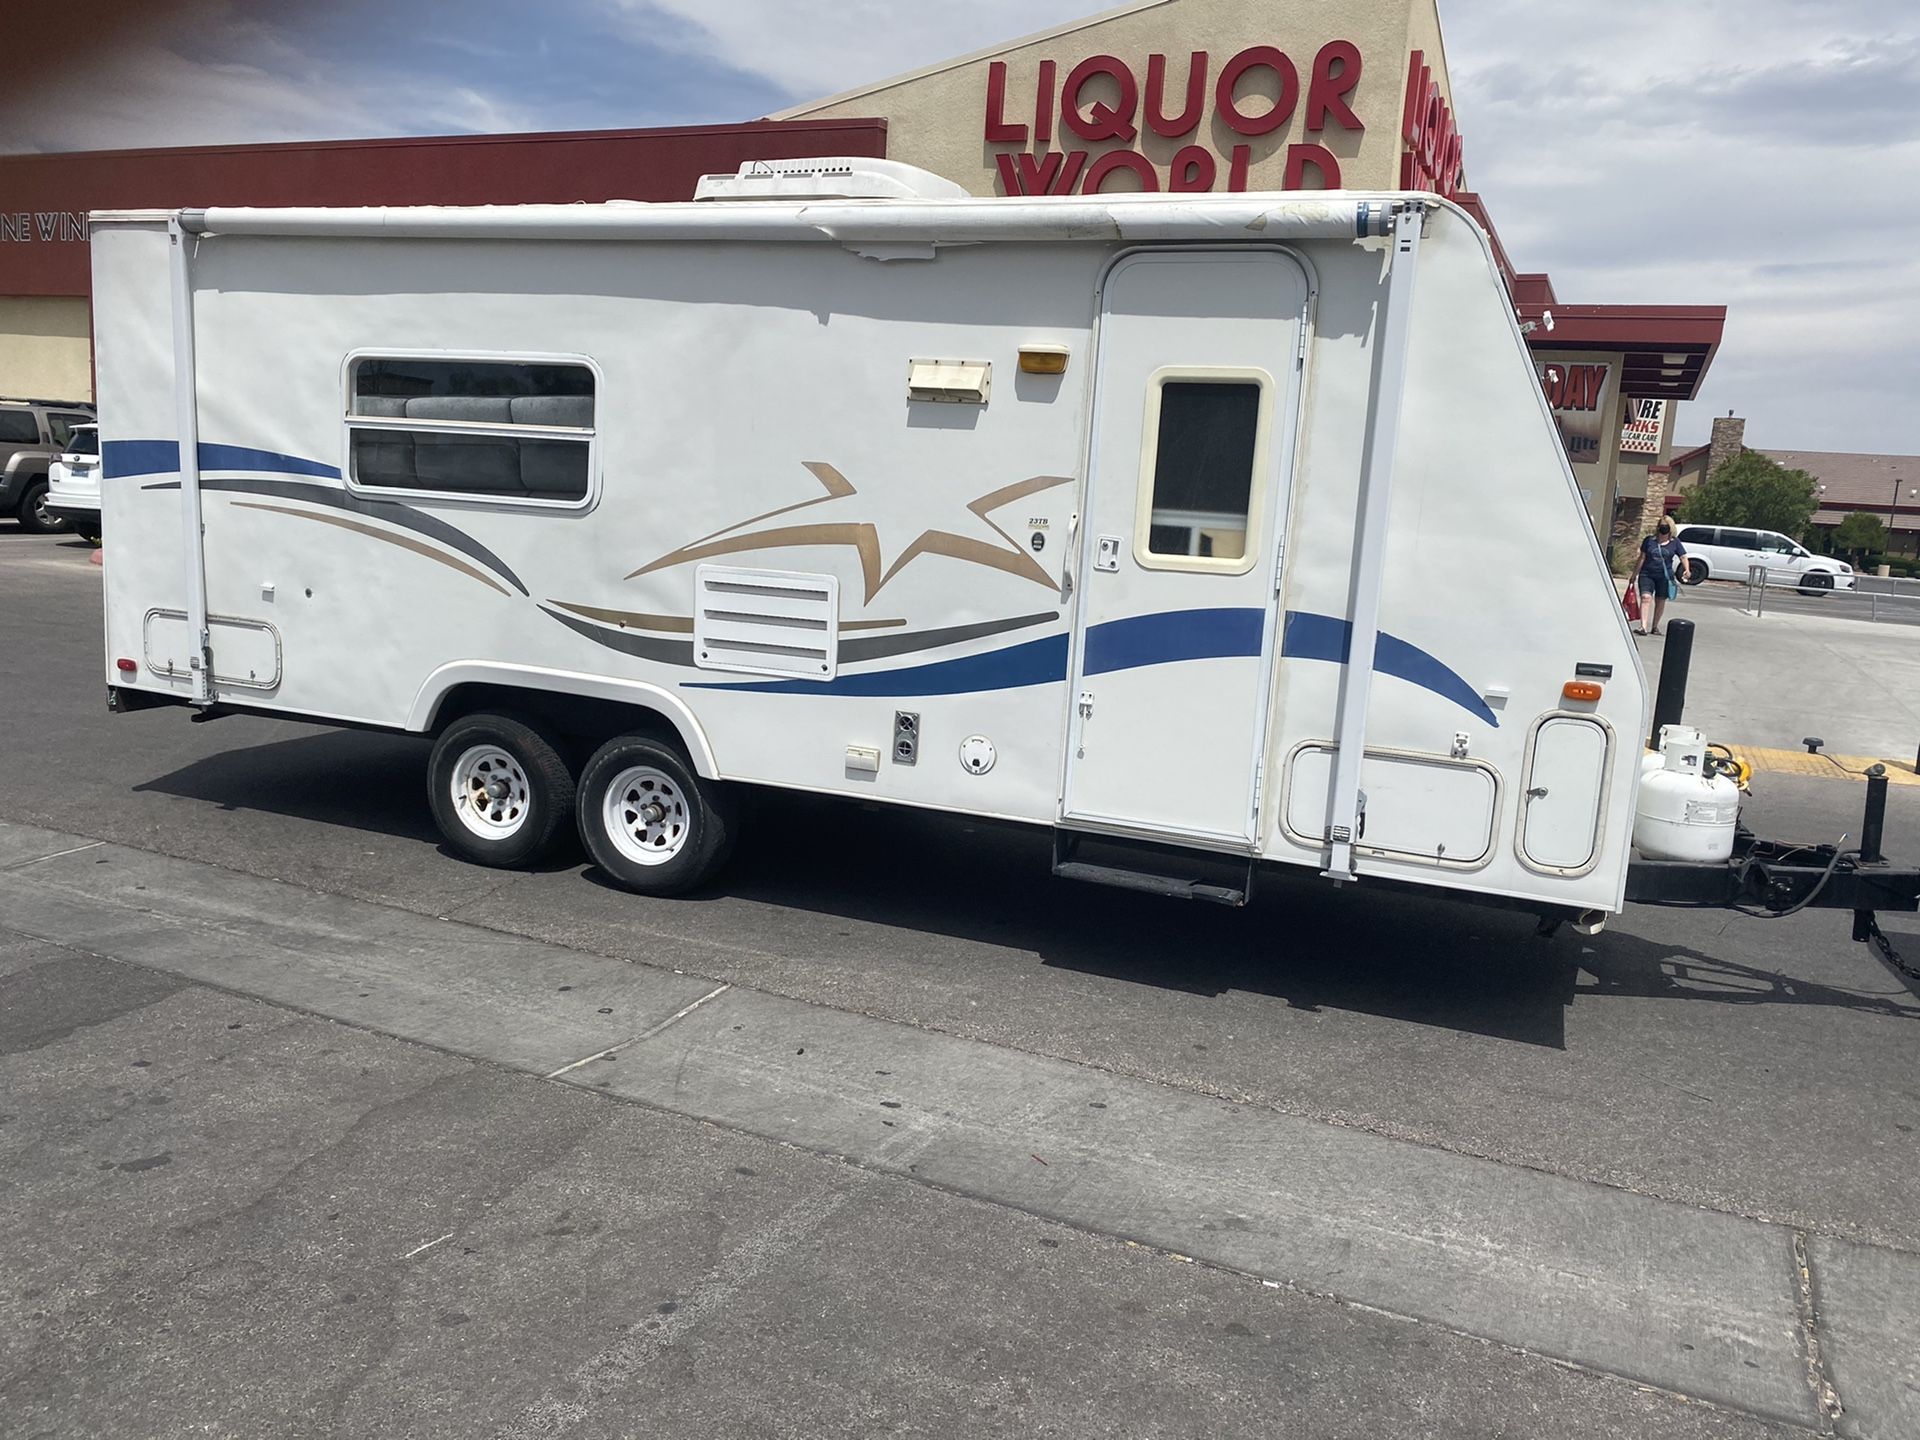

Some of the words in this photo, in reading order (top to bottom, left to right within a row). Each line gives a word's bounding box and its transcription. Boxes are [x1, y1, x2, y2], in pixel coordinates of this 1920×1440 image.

[985, 40, 1365, 142] LIQUOR
[1544, 364, 1607, 411] DAY
[1628, 432, 1641, 440] CAR
[1641, 433, 1658, 441] CARE
